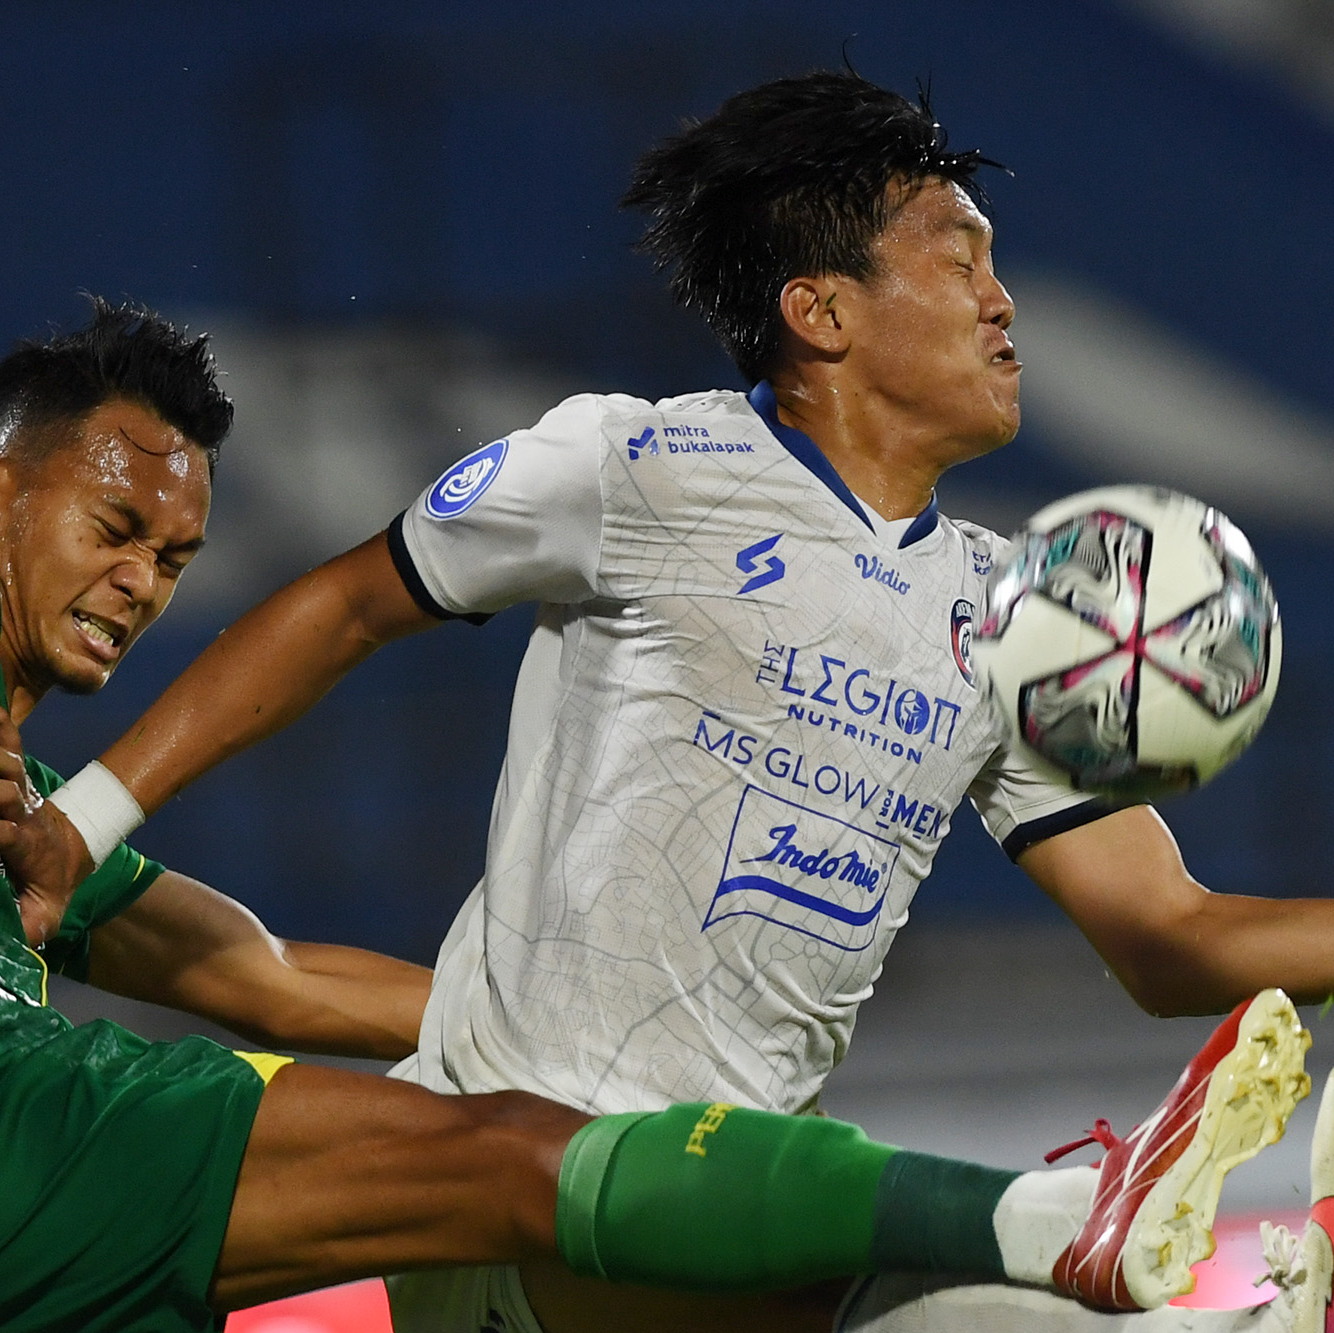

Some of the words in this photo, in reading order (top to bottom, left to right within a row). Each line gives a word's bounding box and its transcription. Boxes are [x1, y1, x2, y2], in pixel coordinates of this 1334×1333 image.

[663, 424, 709, 438] mitra
[668, 441, 755, 454] bukalapak
[854, 553, 911, 596] Vidio
[787, 704, 923, 764] NUTRITION
[693, 717, 758, 765] MS
[765, 747, 880, 809] GLOW
[878, 789, 895, 817] FOR
[891, 794, 949, 838] MEN
